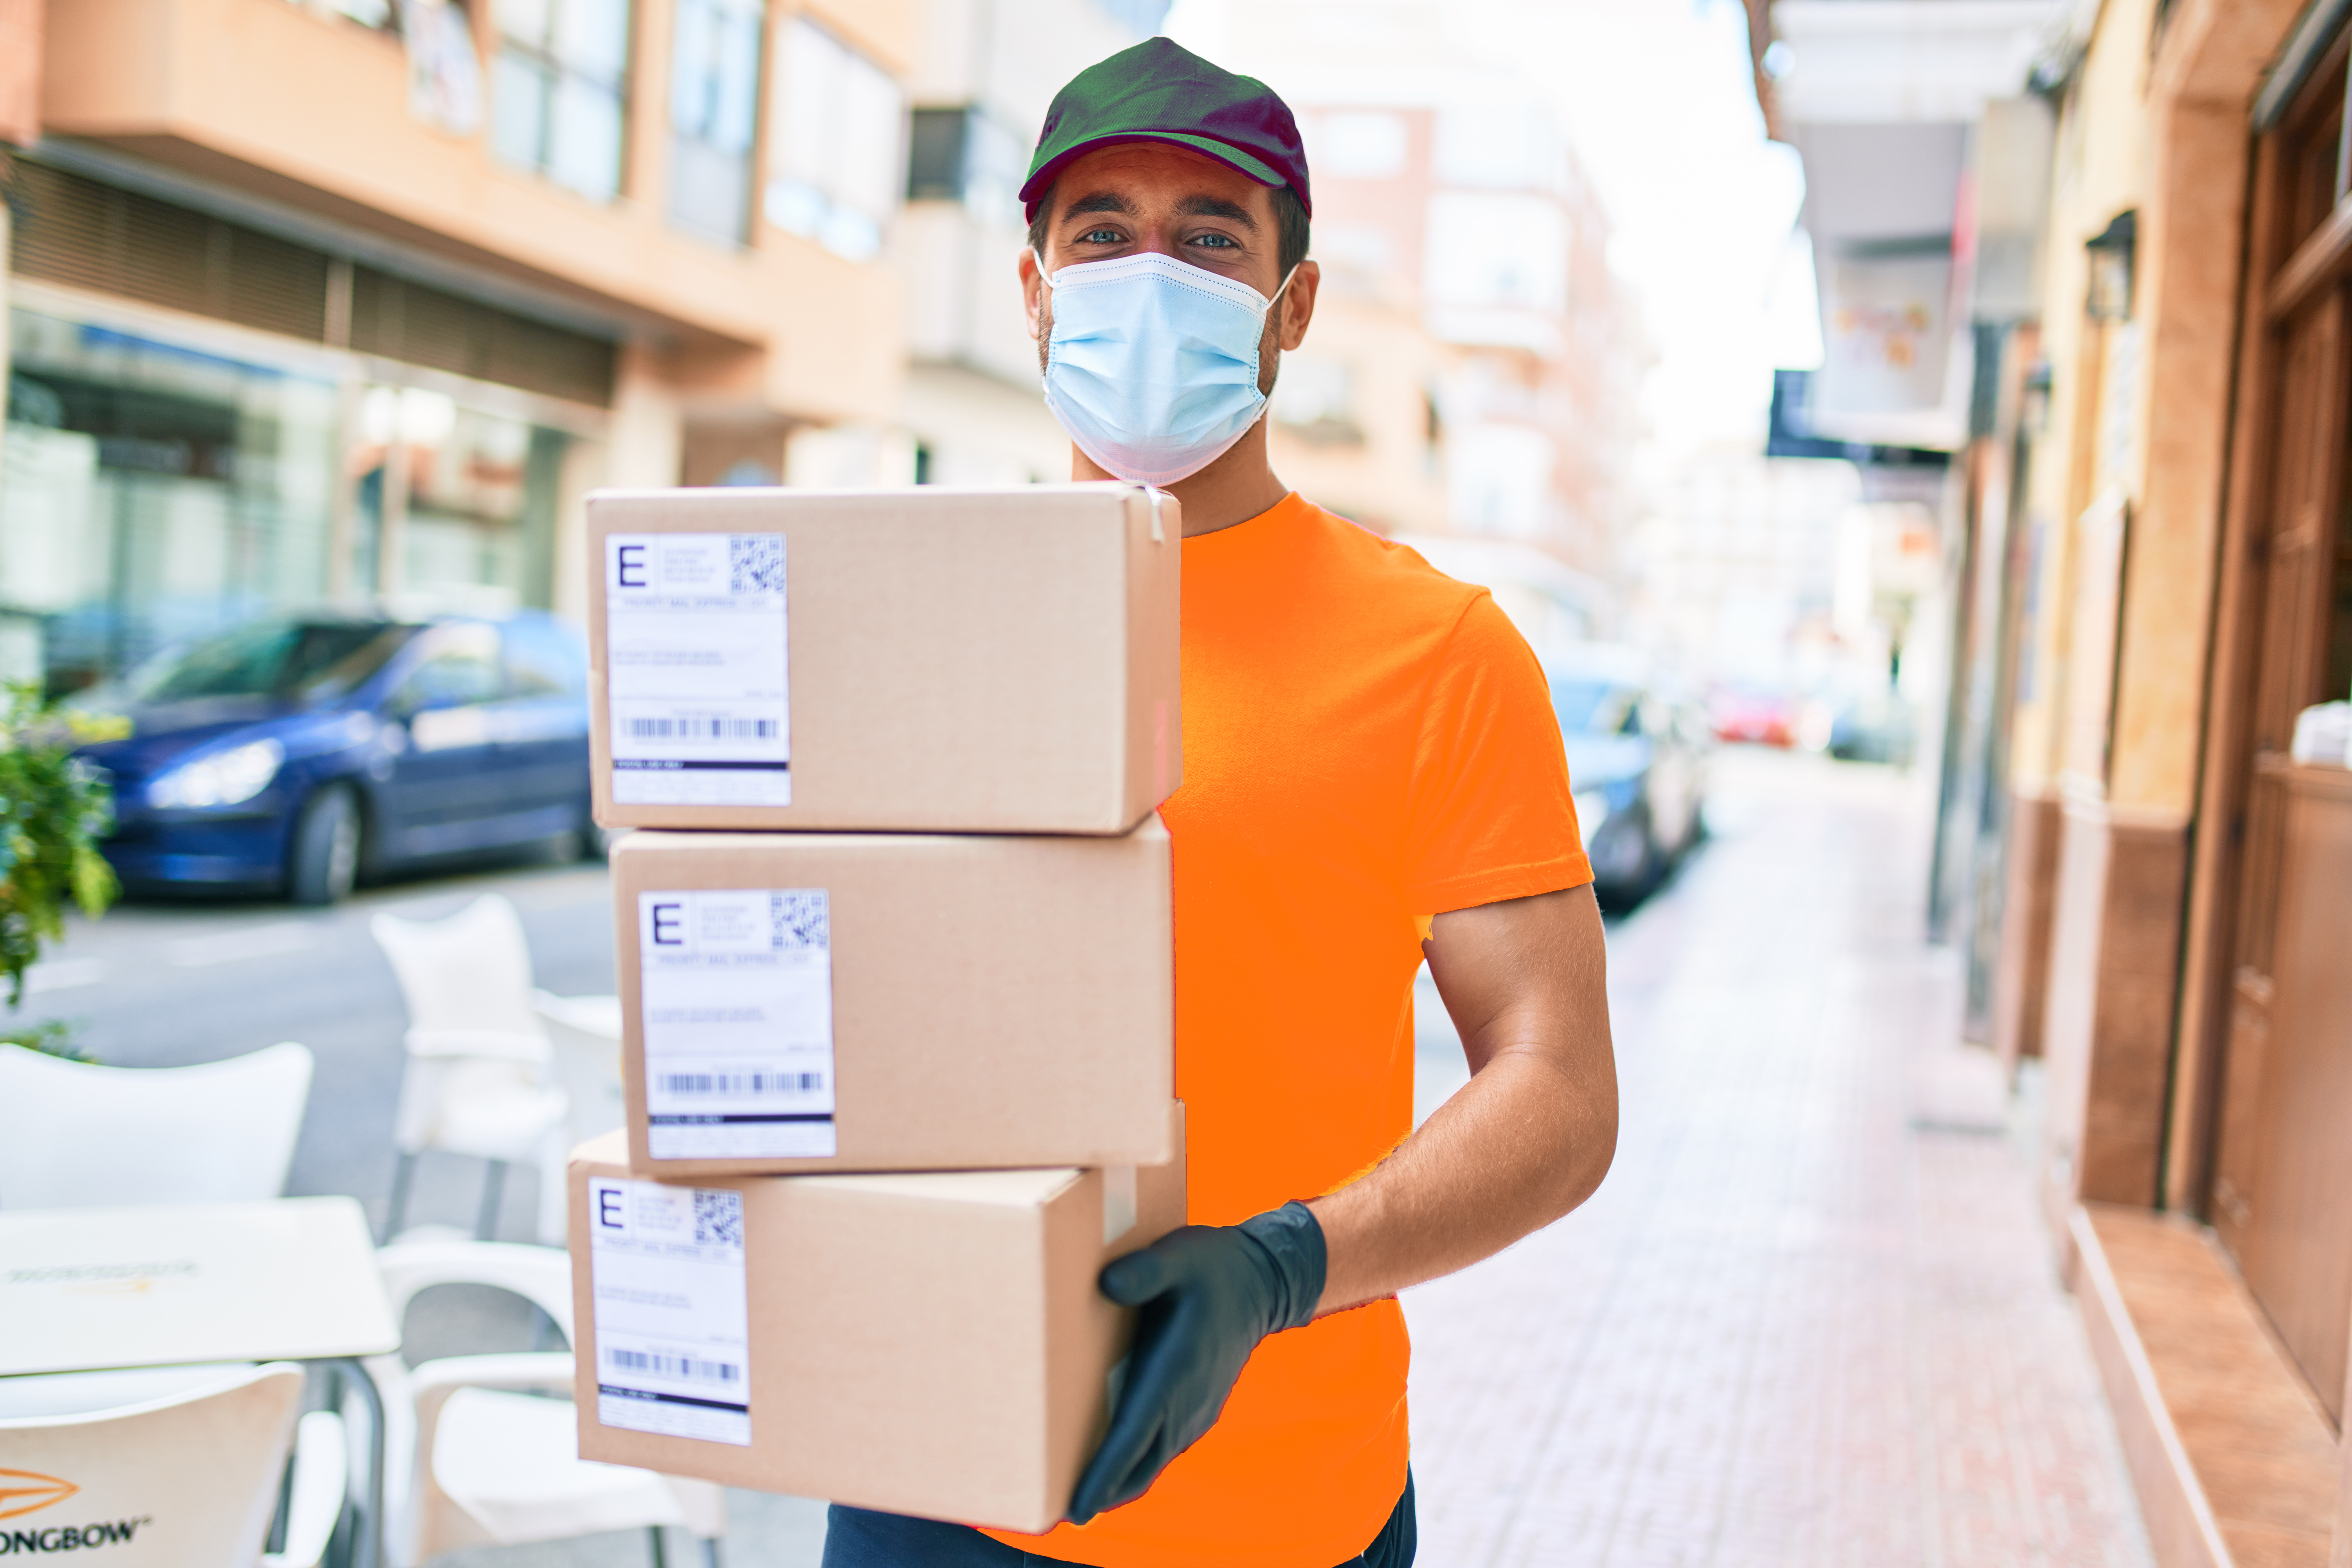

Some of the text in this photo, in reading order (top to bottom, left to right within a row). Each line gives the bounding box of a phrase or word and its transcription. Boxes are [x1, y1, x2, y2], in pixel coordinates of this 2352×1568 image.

[619, 545, 646, 587] E
[653, 903, 684, 944] E
[599, 1189, 623, 1228] E
